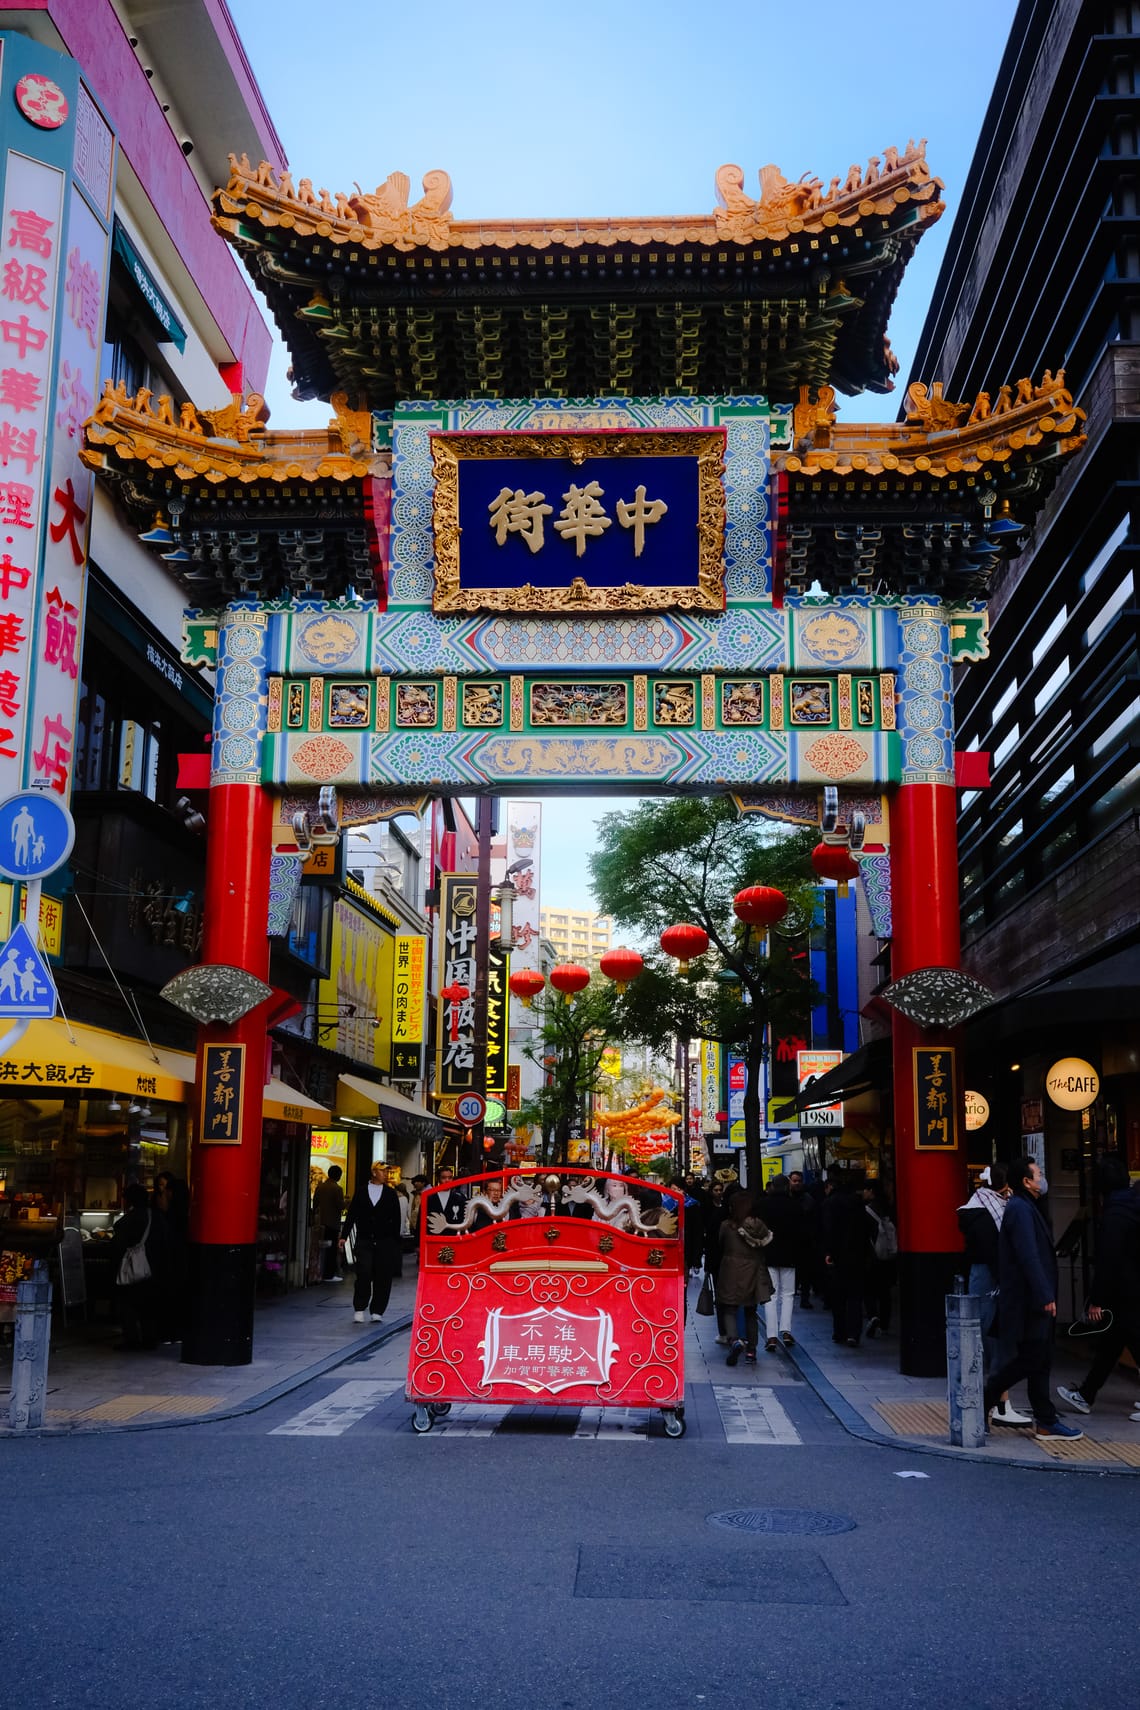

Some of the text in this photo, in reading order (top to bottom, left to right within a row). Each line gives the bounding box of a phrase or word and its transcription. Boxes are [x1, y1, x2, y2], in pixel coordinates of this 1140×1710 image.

[487, 479, 669, 558] 中華街
[395, 941, 409, 1037] 世界一の肉まん
[409, 937, 424, 1041] 中国料理世界チャンピオン
[1049, 1076, 1097, 1093] The CAFE
[461, 1100, 480, 1117] 30
[803, 1111, 834, 1125] 1980
[520, 1324, 577, 1341] 不准
[499, 1344, 597, 1363] 車馬駛入
[503, 1365, 590, 1377] 加賀町警察署
